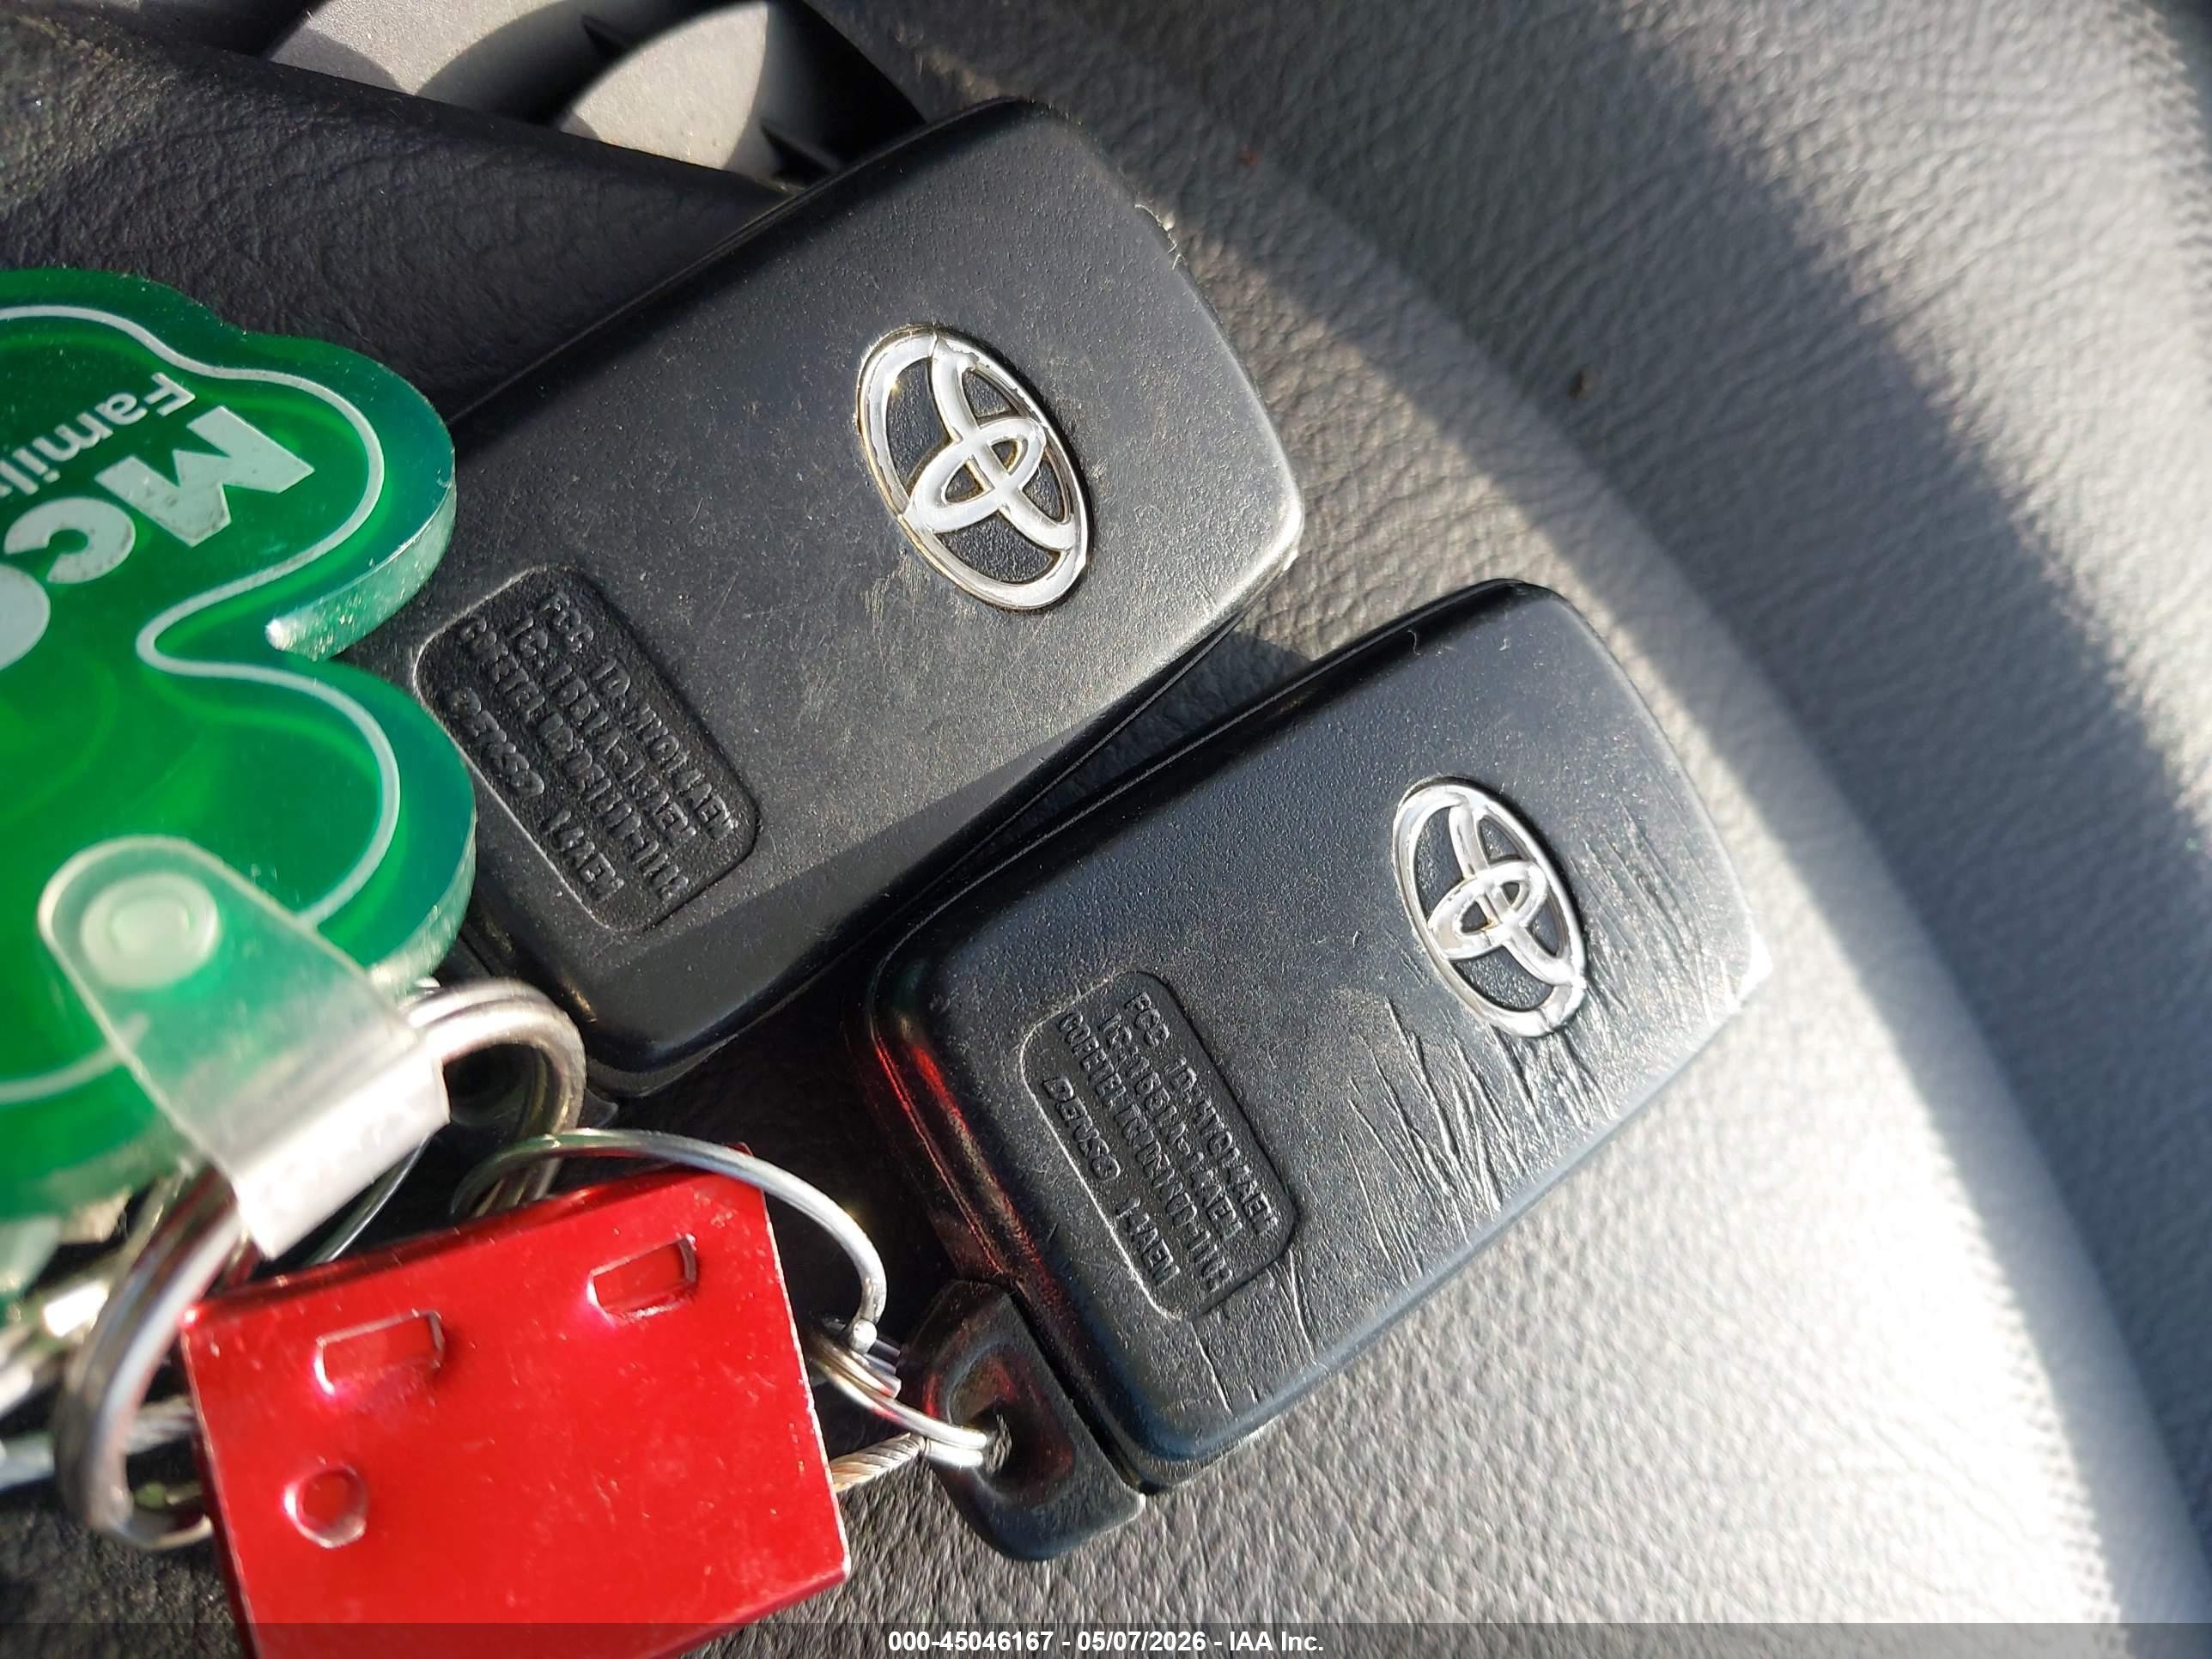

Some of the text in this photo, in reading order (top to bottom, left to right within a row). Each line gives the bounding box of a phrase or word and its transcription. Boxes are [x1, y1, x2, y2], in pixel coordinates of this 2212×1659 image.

[1055, 1009, 1128, 1109] COFETEL
[1122, 990, 1172, 1049] FCC
[1041, 1077, 1182, 1288] DENSO 14AEM
